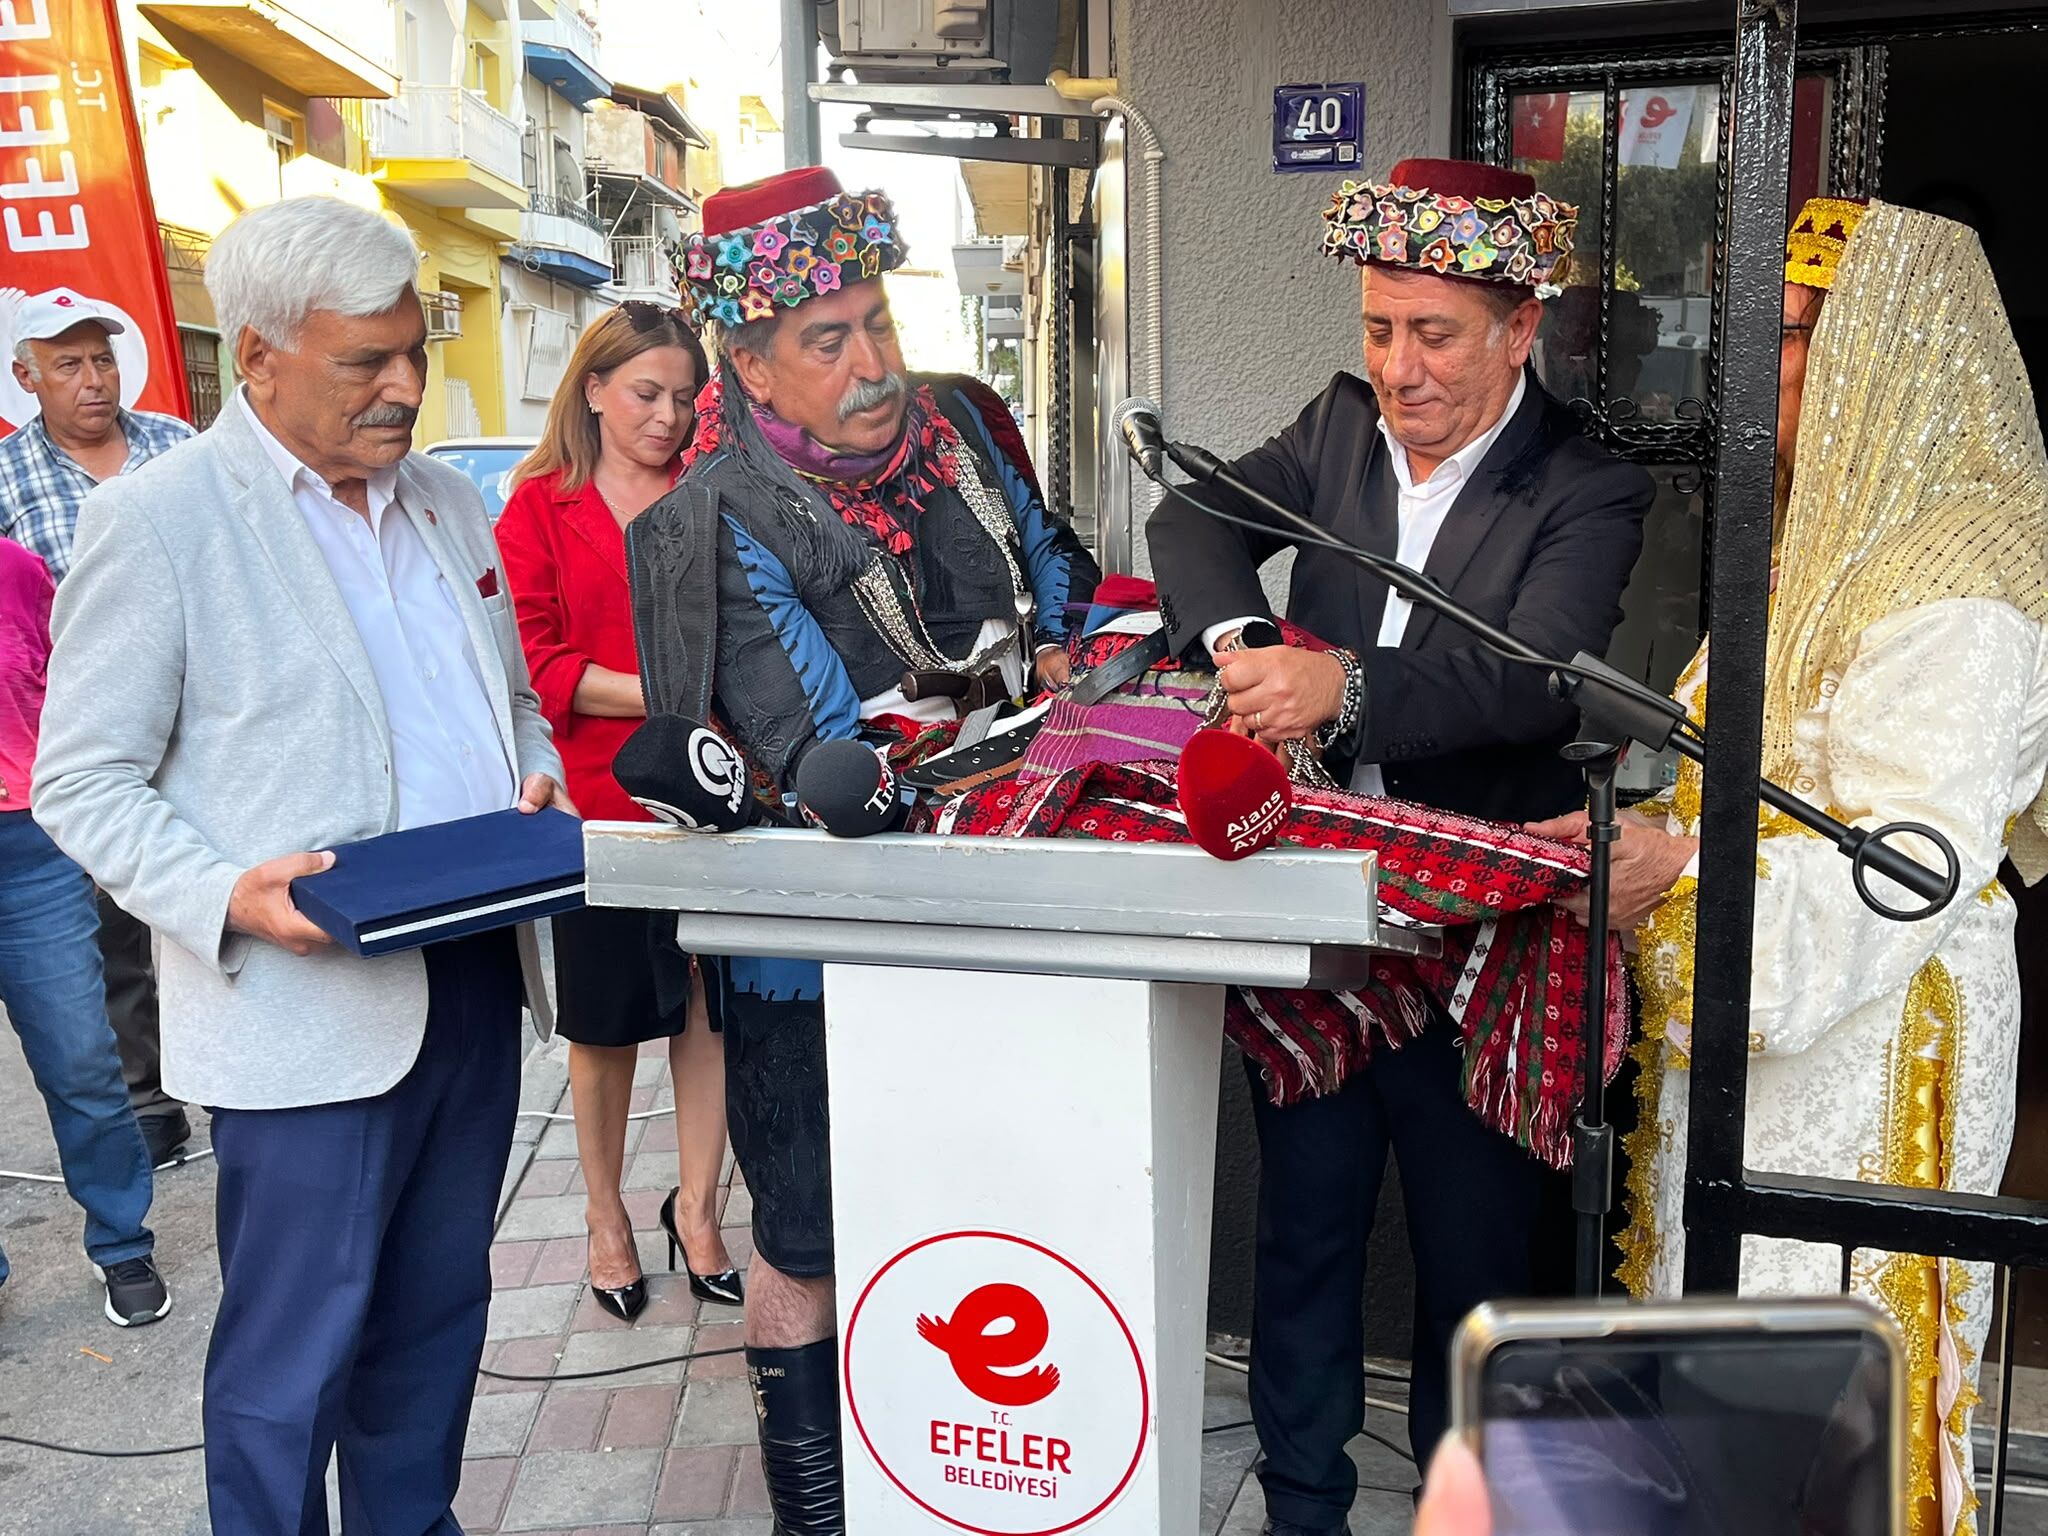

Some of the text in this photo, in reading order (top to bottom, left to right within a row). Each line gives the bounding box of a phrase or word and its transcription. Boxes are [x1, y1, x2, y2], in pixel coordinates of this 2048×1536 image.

[1297, 97, 1341, 134] 40
[1227, 790, 1281, 838] Ajans
[761, 1366, 785, 1377] SARI
[990, 1410, 1013, 1426] T.C.
[930, 1419, 1072, 1475] EFELER
[944, 1464, 1057, 1499] BELEDİYESİ
